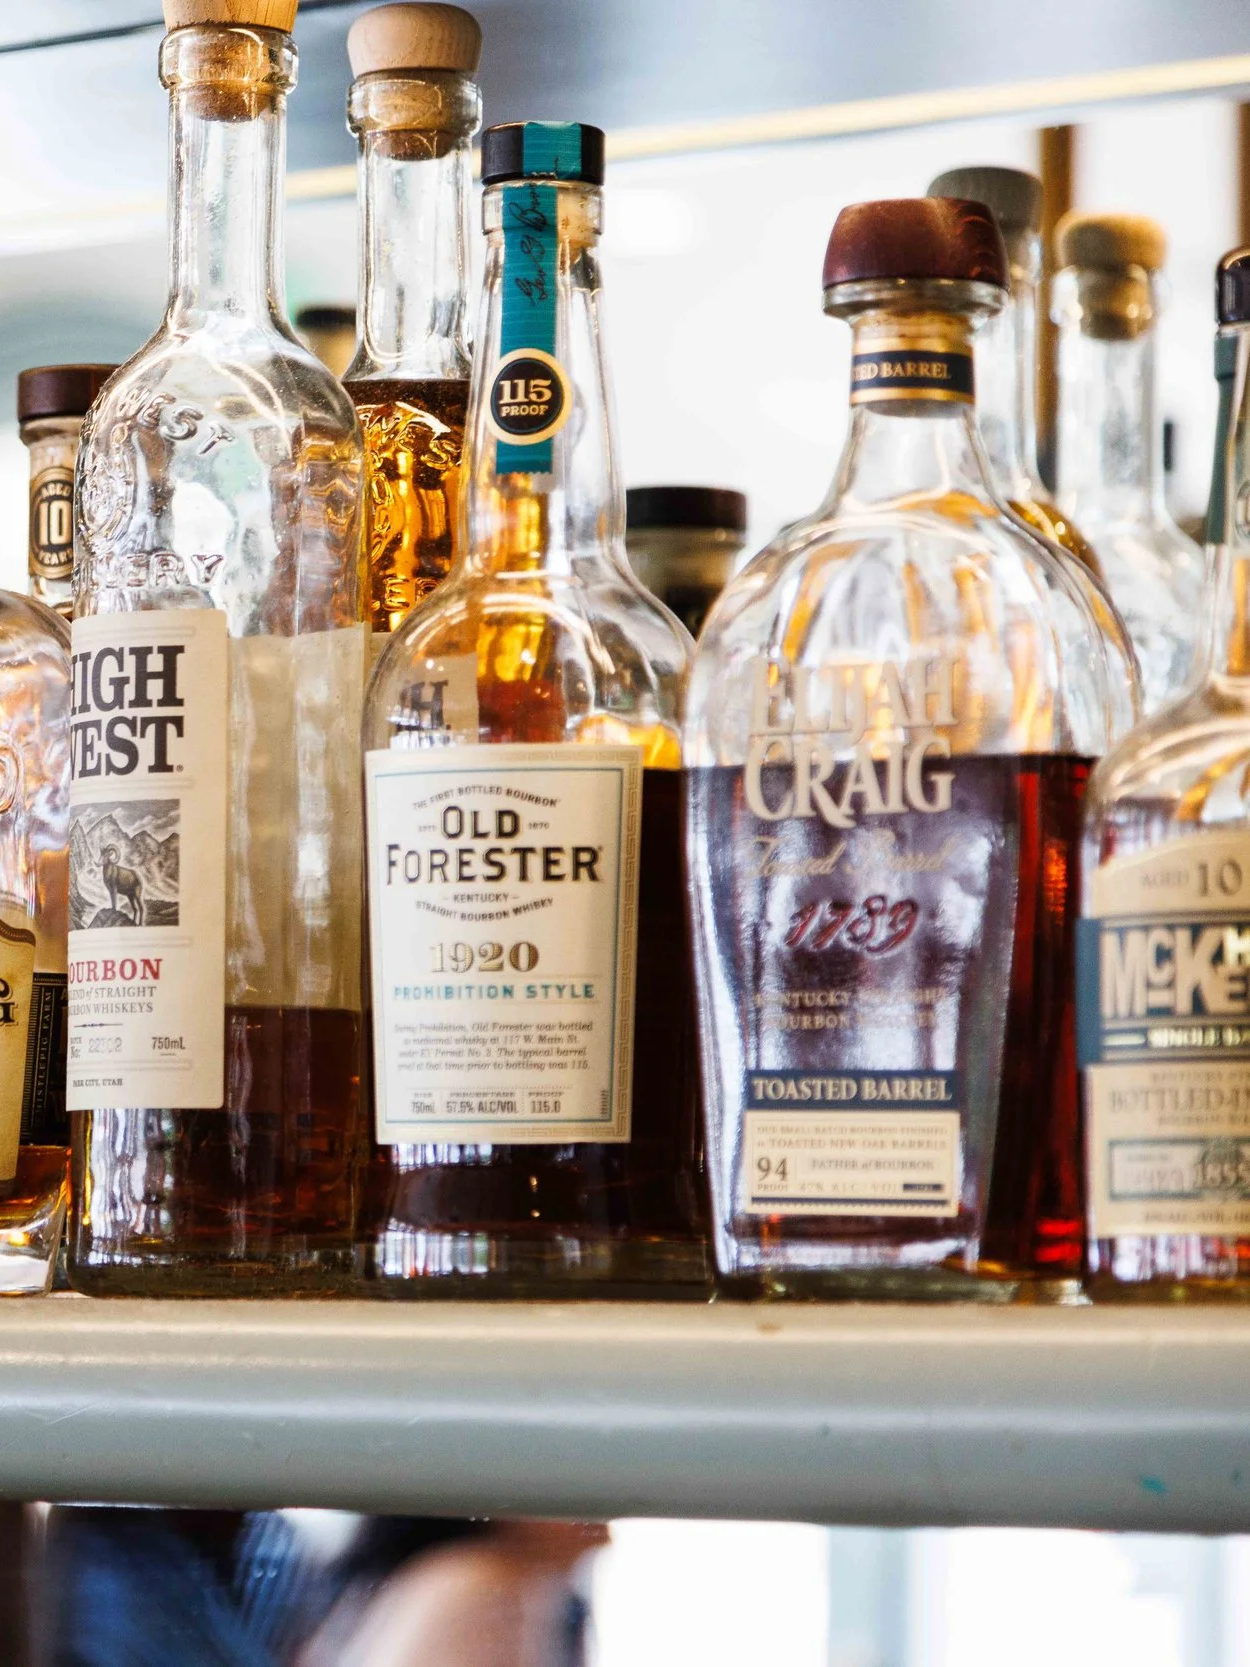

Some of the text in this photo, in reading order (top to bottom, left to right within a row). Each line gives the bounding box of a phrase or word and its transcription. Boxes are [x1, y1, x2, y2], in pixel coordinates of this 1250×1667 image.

[880, 361, 952, 379] BARREL
[499, 379, 552, 403] 115
[502, 404, 549, 417] PROOF
[38, 500, 72, 546] 10
[750, 656, 960, 744] ELIJAH
[745, 734, 955, 829] CRAIG
[441, 804, 521, 840] OLD
[386, 843, 601, 886] FORESTER
[1197, 857, 1244, 897] 10
[783, 895, 919, 954] 1789
[429, 940, 540, 974] 1920
[95, 986, 157, 999] STRAIGHT
[393, 983, 595, 1001] PROHIBITION STYLE
[93, 1002, 154, 1015] WHISKEYS
[151, 1036, 186, 1051] 750mL
[102, 1078, 123, 1087] UTAH
[753, 1077, 953, 1100] TOASTED BARREL
[756, 1155, 789, 1183] 94
